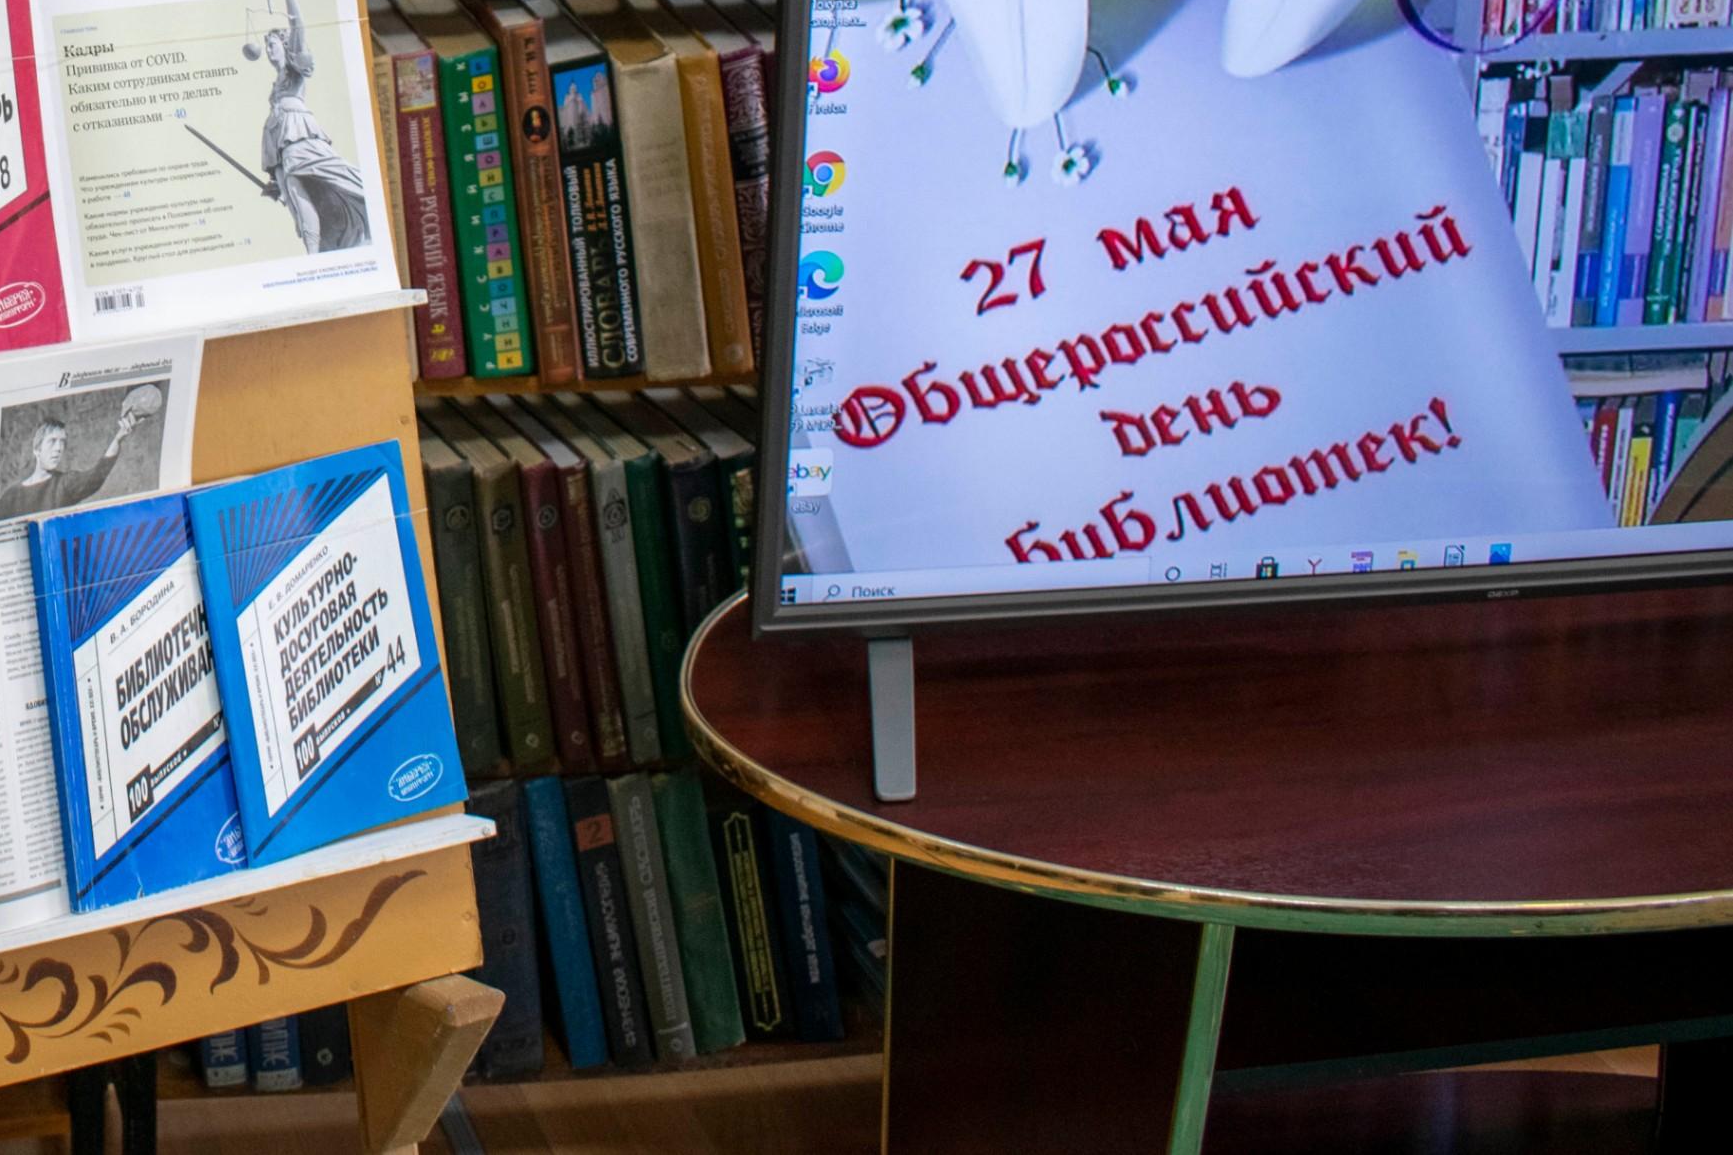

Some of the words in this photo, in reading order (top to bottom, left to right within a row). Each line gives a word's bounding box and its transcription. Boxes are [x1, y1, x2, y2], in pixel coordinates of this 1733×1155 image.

[63, 43, 115, 60] Кадры
[66, 61, 128, 78] Прививка
[130, 59, 144, 69] от
[146, 52, 188, 68] COVID.
[68, 81, 111, 96] Каким
[113, 71, 191, 90] сотрудникам
[193, 65, 239, 80] ставить
[70, 96, 147, 114] обязательно
[159, 90, 180, 103] что
[182, 86, 222, 102] делать
[82, 112, 163, 132] отказниками
[564, 165, 584, 233] ТОЛКОВЫЙ
[605, 158, 622, 201] ЯЗЫКА
[419, 196, 445, 267] РУССКИЙ
[611, 204, 627, 265] РУССКОГО
[961, 241, 1048, 316] 27
[1098, 185, 1262, 272] мая
[426, 273, 448, 318] ЯЗЫК
[572, 237, 599, 367] ИЛЛЮСТРИРОВАННЫЙ
[618, 267, 639, 362] СОВРЕМЕННОГО
[831, 205, 1473, 451] Общероссийский
[1102, 380, 1283, 462] день
[284, 545, 329, 594] ДОМАРЕНКО
[851, 585, 896, 599] Поиск
[129, 580, 176, 626] БОРОДИНА
[274, 551, 358, 645] КУЛЬТУРНО-
[280, 581, 357, 680] ДОСУГОВАЯ
[284, 587, 389, 704] ДЕЯТЕЛЬНОСТЬ
[288, 625, 380, 732] БИБЛИОТЕКИ
[386, 636, 406, 675] 44
[296, 733, 316, 772] 100
[128, 775, 150, 815] 100
[586, 820, 605, 845] 2
